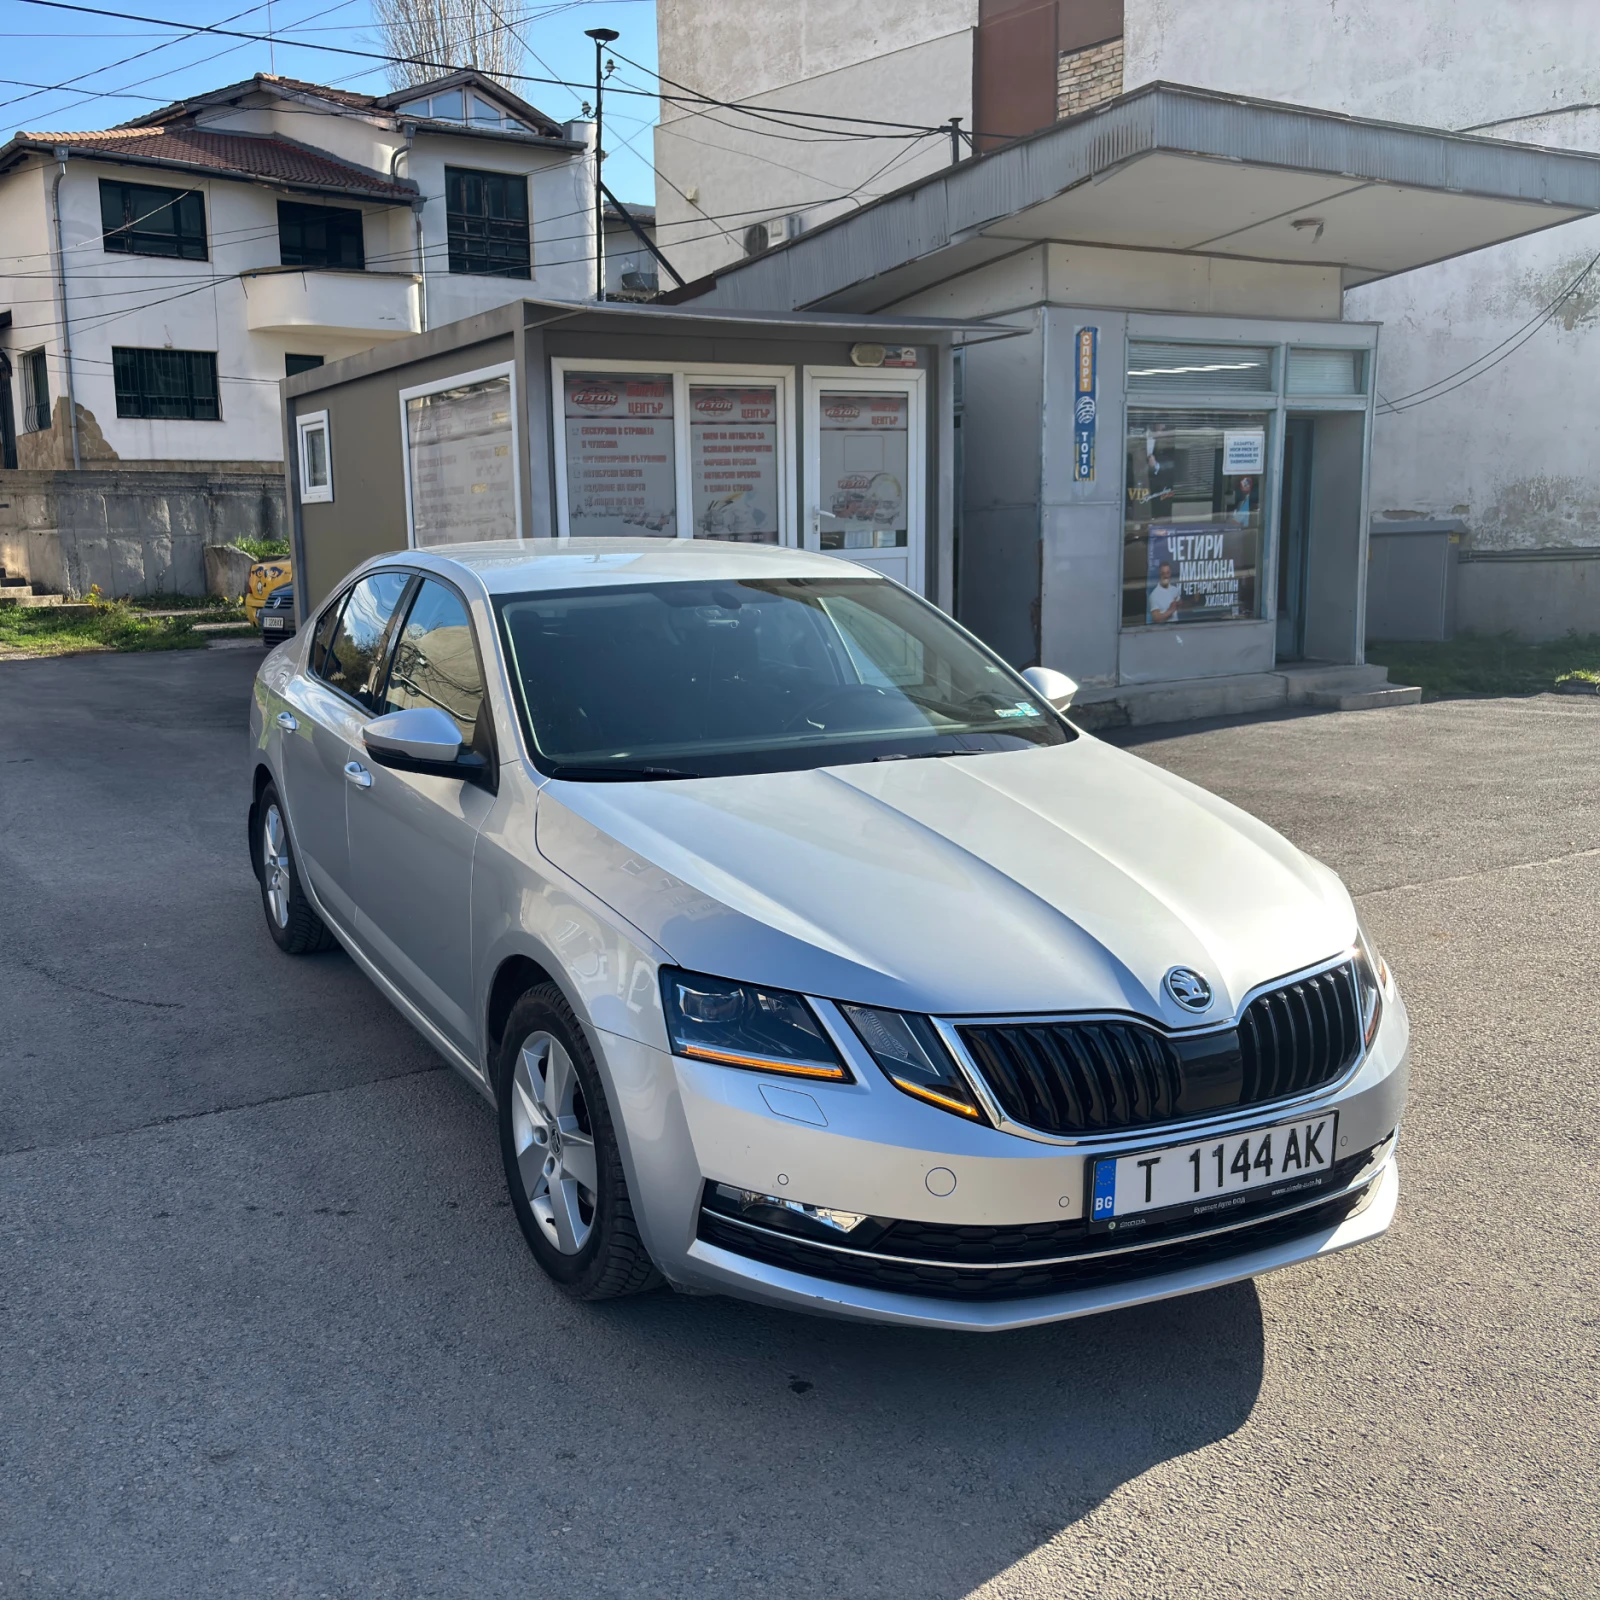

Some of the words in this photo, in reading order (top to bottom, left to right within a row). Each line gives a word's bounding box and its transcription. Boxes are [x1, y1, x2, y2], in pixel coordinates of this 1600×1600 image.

[1081, 334, 1090, 389] СПОРТ
[628, 402, 664, 415] ЦЕНТЪР
[741, 408, 770, 419] ЦЕНТЪР
[1080, 431, 1089, 475] ТОТО
[1127, 488, 1150, 501] VIP
[1167, 534, 1224, 561] ЧЕТИРИ
[1179, 559, 1235, 581] МИЛИОНА
[1183, 580, 1239, 595] ЧЕТИРИСТОТИН
[1204, 594, 1234, 607] ХИЛЯДИ
[1137, 1156, 1161, 1203] T
[1189, 1133, 1273, 1193] 1144
[1282, 1121, 1325, 1173] AK
[1095, 1196, 1113, 1212] BG
